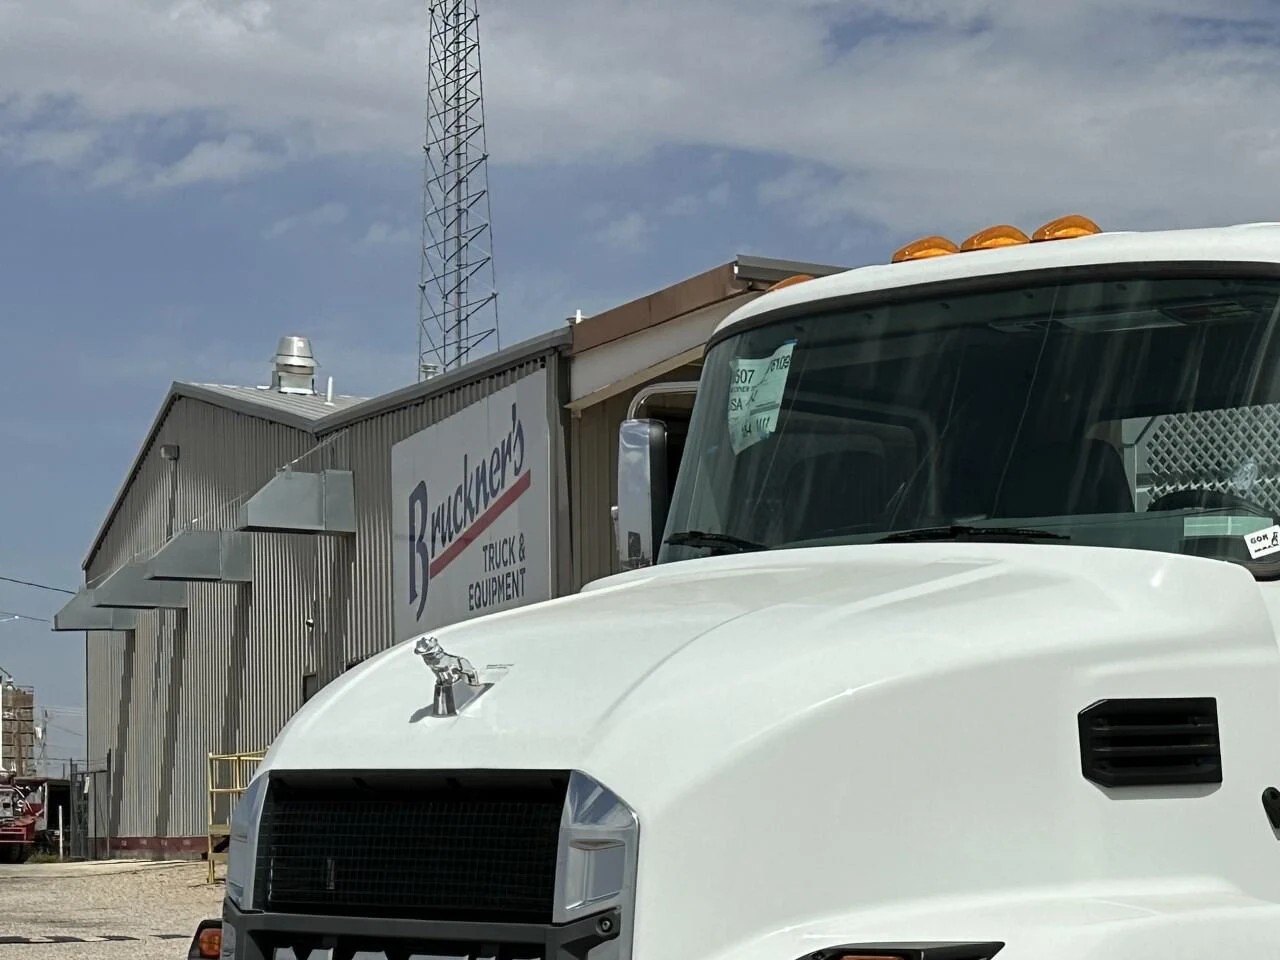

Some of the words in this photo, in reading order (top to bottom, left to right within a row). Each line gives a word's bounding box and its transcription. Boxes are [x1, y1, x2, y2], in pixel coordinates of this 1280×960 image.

[408, 402, 525, 622] Bruckner's
[482, 535, 516, 573] TRUCK
[518, 532, 526, 562] &
[468, 567, 526, 612] EQUIPMENT
